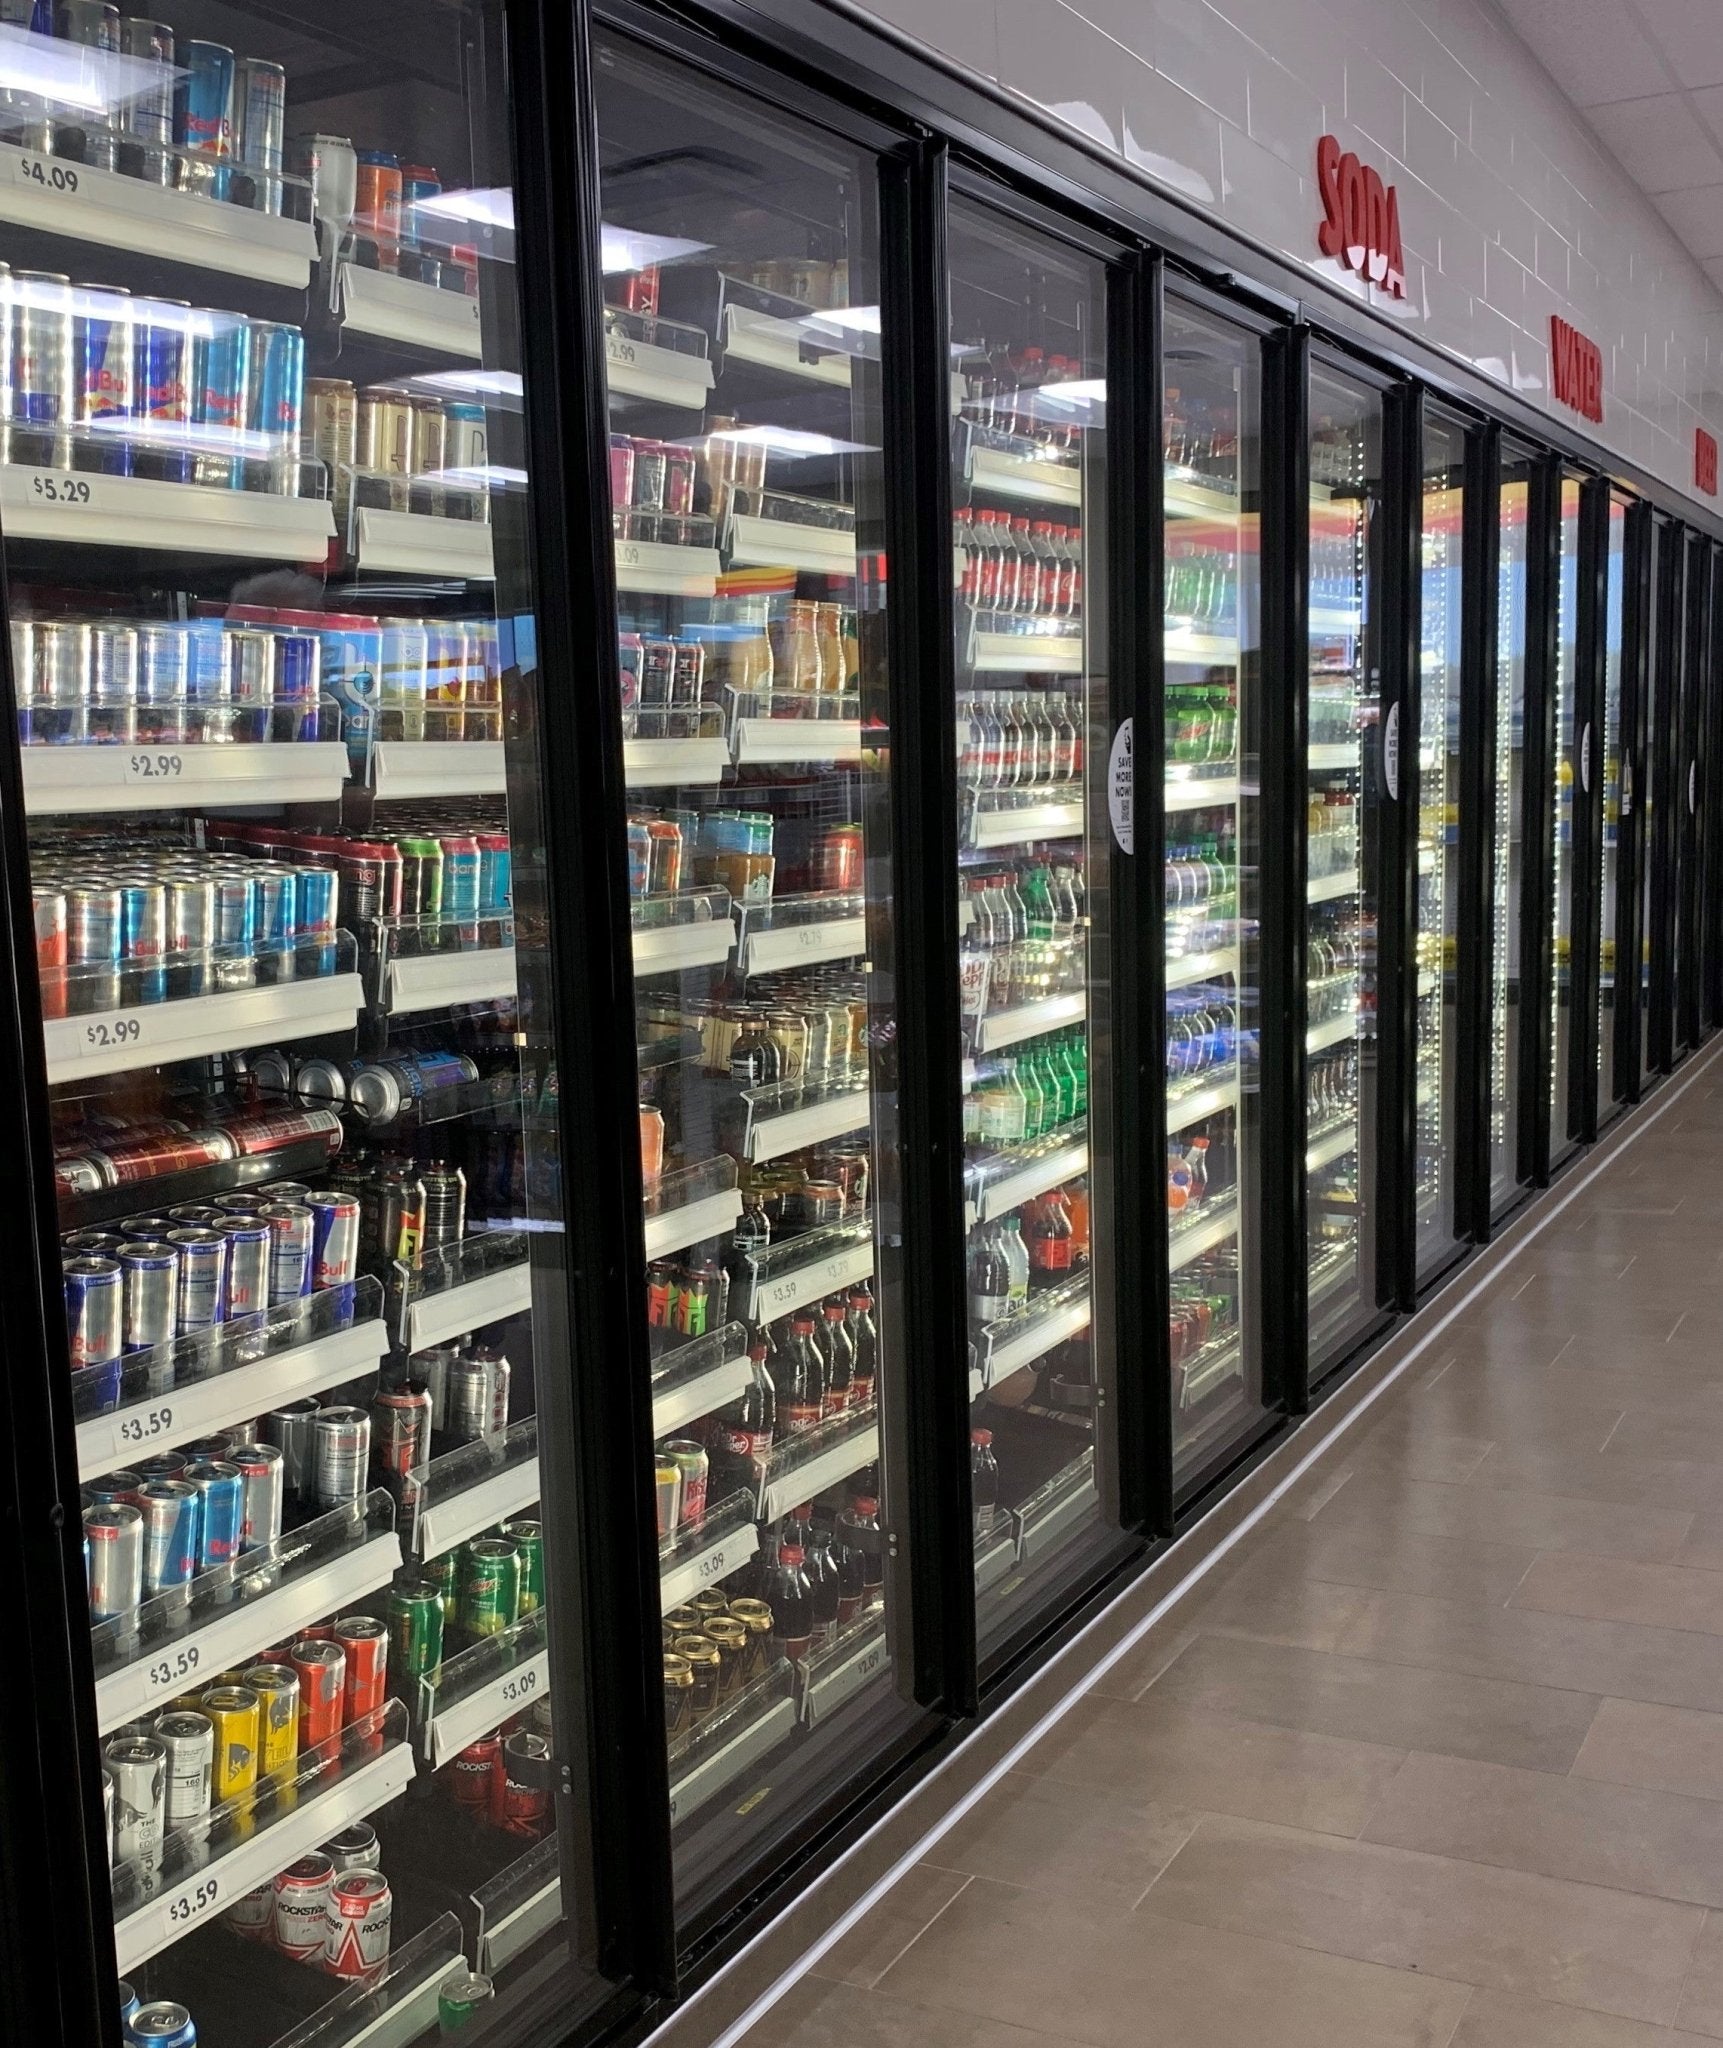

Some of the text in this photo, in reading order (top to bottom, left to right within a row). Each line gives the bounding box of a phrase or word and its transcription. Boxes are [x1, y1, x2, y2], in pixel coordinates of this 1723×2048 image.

[21, 158, 79, 193] $4.09
[1317, 135, 1406, 300] SODA
[1551, 315, 1603, 424] WATER
[34, 476, 91, 503] $5.29
[131, 755, 182, 776] $2.99
[1118, 757, 1132, 768] SAVE
[1116, 771, 1132, 783] MORE
[87, 1019, 140, 1046] $2.99
[318, 1260, 347, 1276] Bull
[773, 1282, 797, 1302] $3.59
[71, 1336, 106, 1354] Bull
[121, 1407, 172, 1441] $3.59
[700, 1552, 725, 1577] $3.09
[150, 1647, 199, 1685] $3.59
[502, 1670, 536, 1701] $3.09
[170, 1879, 218, 1921] $3.59
